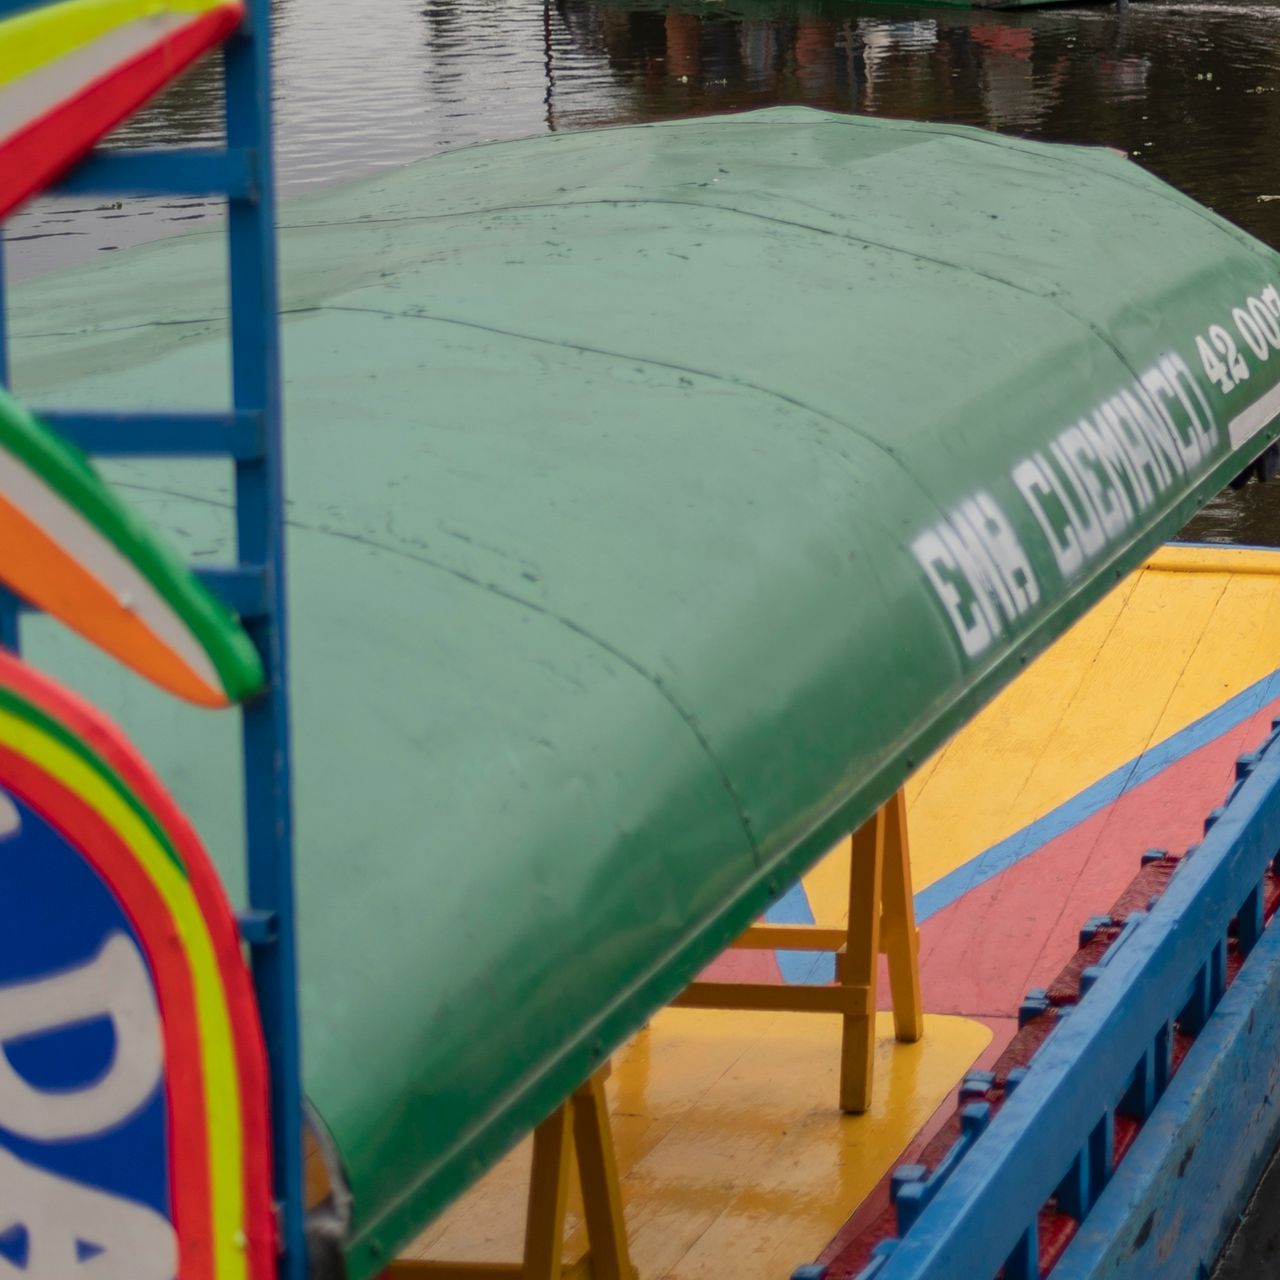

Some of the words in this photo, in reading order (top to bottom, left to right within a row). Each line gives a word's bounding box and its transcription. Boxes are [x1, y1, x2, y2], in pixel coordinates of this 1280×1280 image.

[911, 489, 1041, 658] EMB
[1011, 351, 1219, 580] CUEMANCO
[1194, 324, 1250, 395] 42
